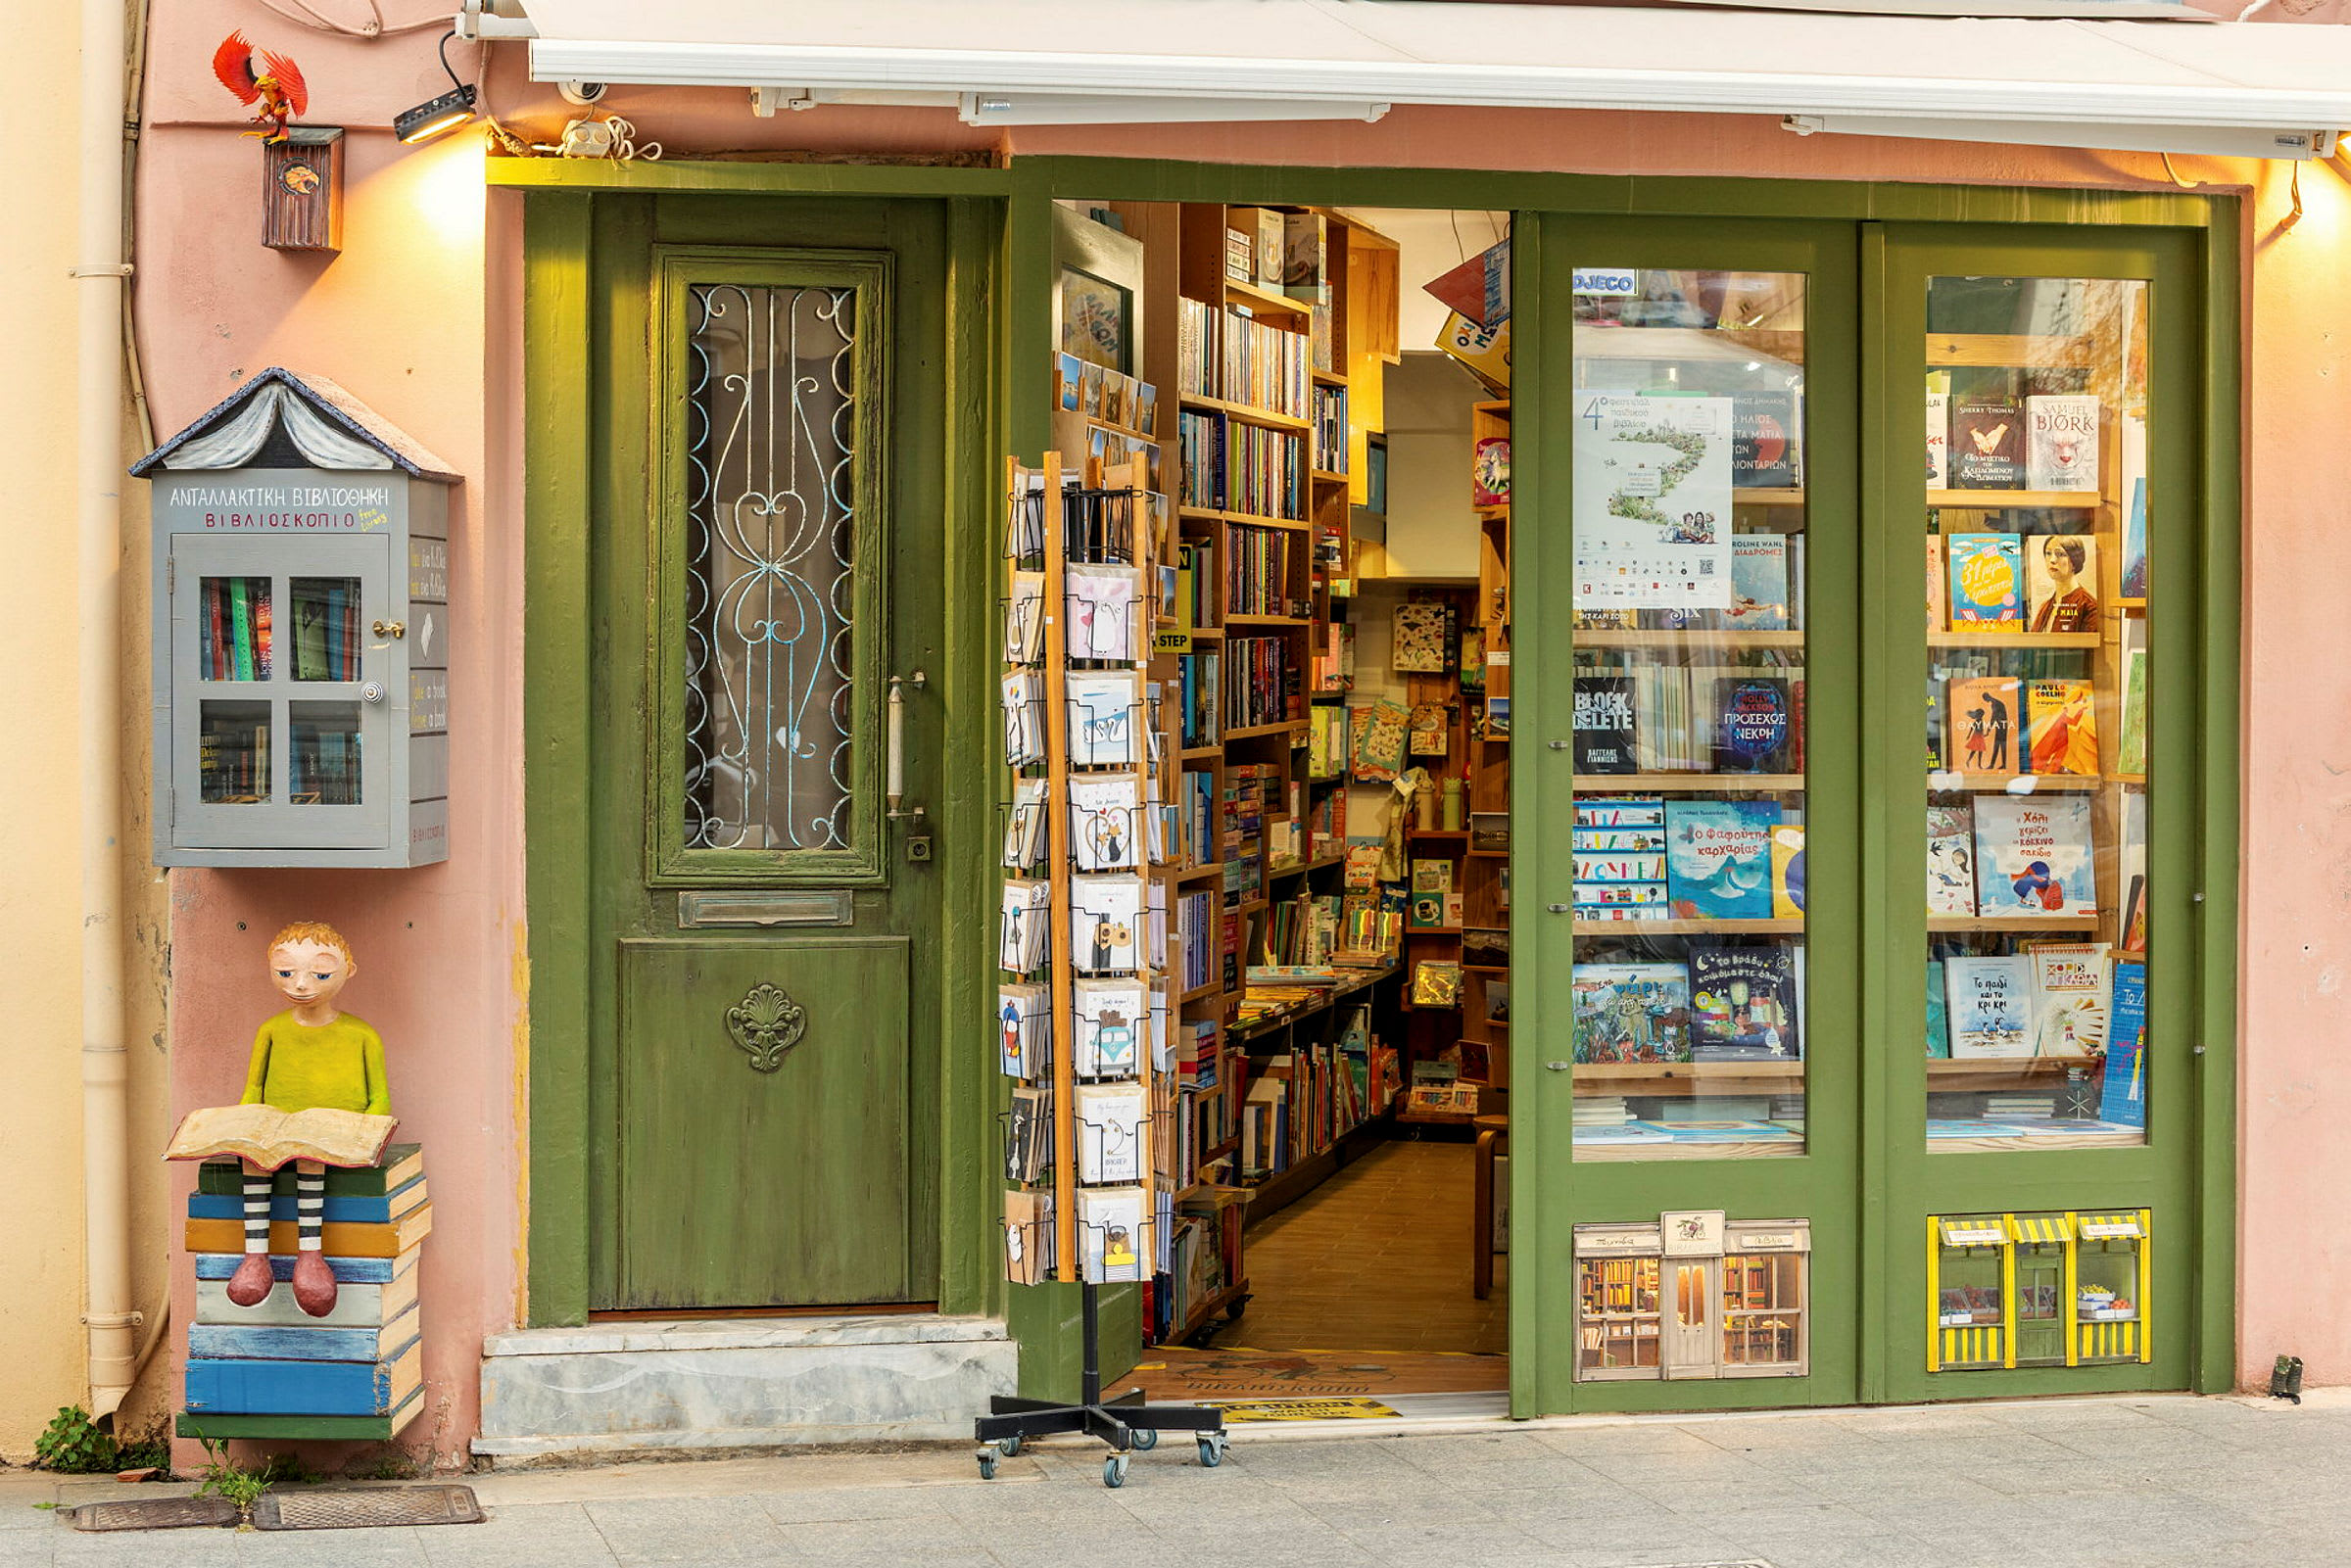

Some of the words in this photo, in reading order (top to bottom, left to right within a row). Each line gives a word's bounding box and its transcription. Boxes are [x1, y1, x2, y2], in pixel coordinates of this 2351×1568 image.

[1572, 274, 1633, 291] DJECO
[2042, 403, 2088, 417] SAMUEL
[1741, 415, 1771, 424] ΗΛΙΟΣ
[2038, 414, 2094, 436] BJØRK
[1751, 430, 1782, 440] ΜΑΤΙΑ
[169, 488, 285, 506] ΑΝΤΑΛΛΑΚΤΙΚΗ
[293, 487, 389, 506] ΒΙΒΛΙΟΘΗΚΗ
[205, 512, 355, 528] ΒΙΒΛΙΟΣΚΟΠΙΟ
[1159, 635, 1187, 646] STEP
[1724, 713, 1786, 725] ΠΡΟΣΕΧΩΣ
[1957, 720, 2016, 731] ΘΑΥΜΑΤΑ
[1736, 728, 1774, 739] ΝΕΚΡΗ
[2020, 837, 2054, 846] κόκκινο
[1698, 843, 1759, 858] καρχαρίας
